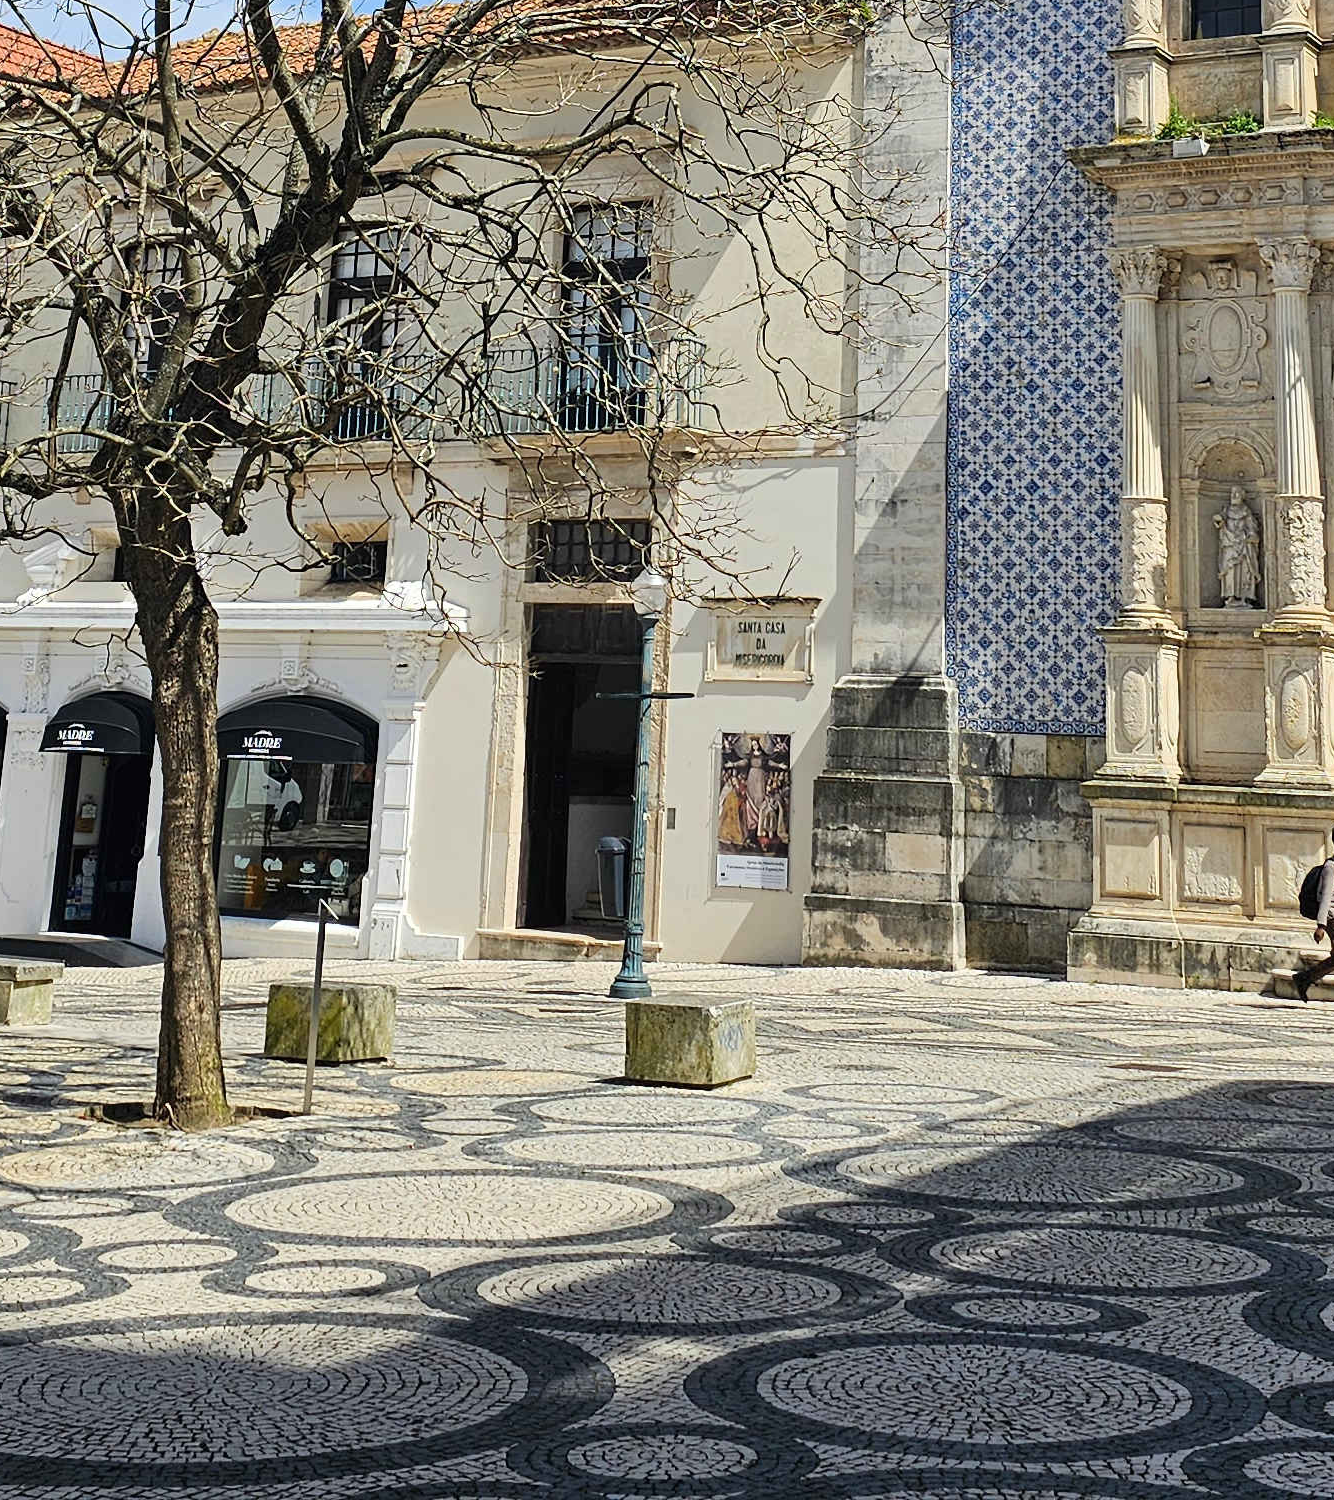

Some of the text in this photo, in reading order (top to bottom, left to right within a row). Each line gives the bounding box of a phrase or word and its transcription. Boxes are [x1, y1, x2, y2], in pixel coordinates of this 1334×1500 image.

[737, 621, 786, 634] SANTA CASA
[755, 637, 766, 650] DA
[56, 729, 95, 741] MADRE
[241, 736, 283, 749] MADRE
